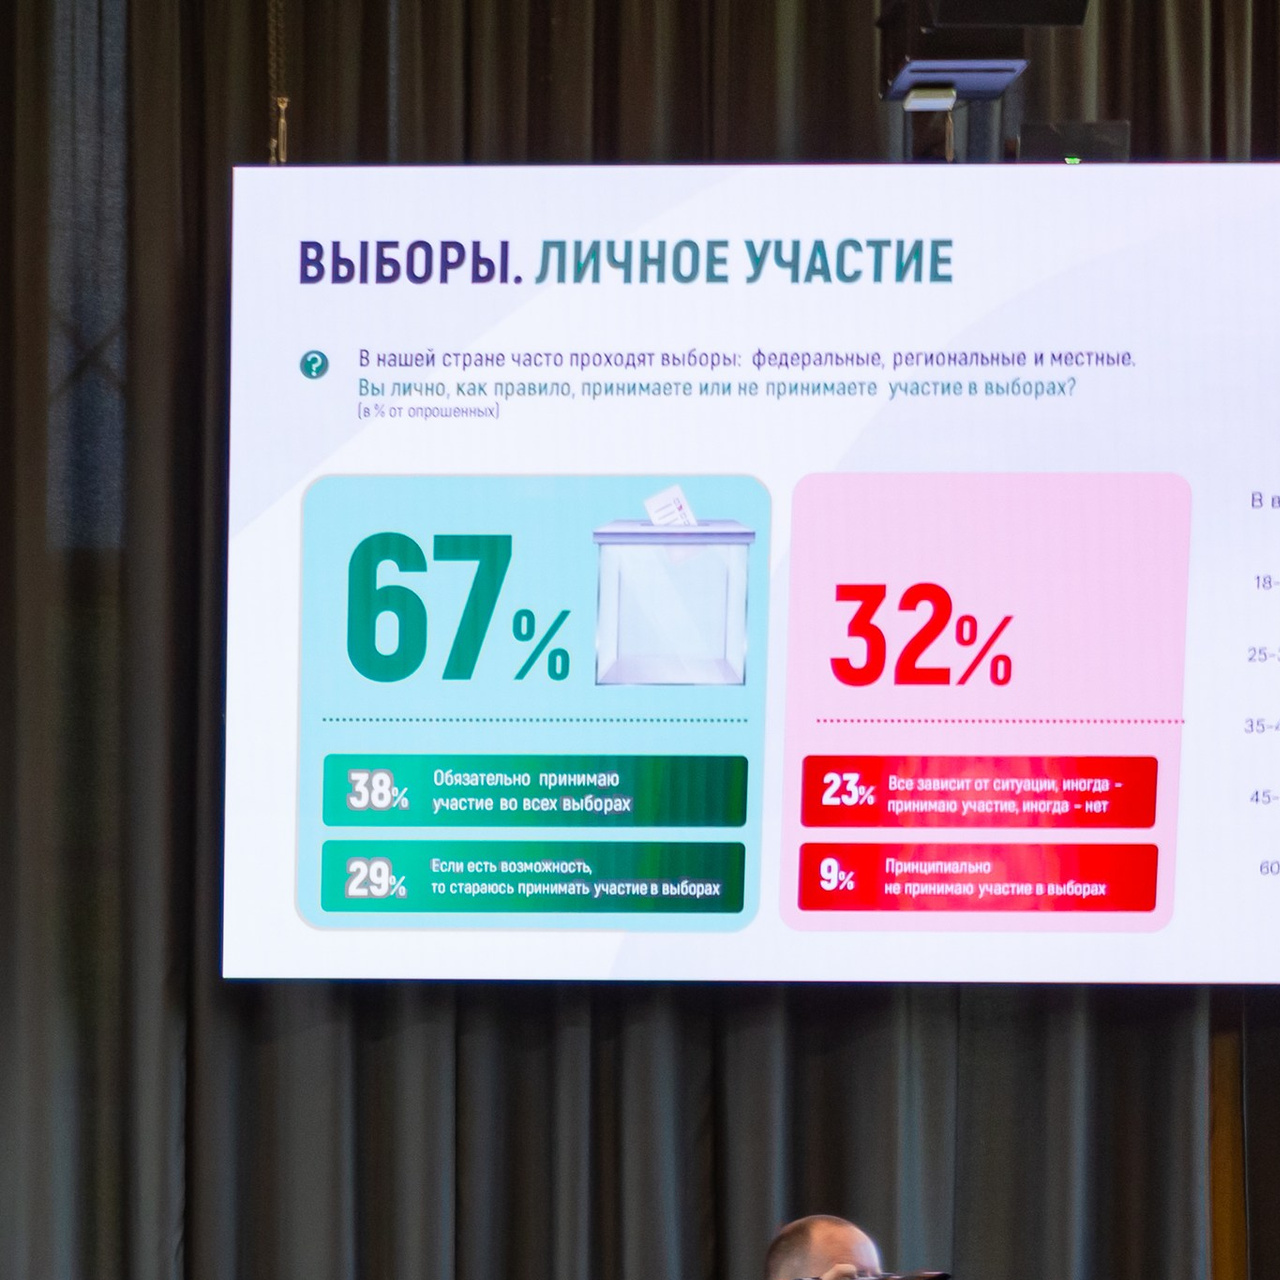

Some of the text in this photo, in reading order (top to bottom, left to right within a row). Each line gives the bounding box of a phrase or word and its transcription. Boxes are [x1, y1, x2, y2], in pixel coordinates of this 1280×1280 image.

[300, 239, 953, 285] ВЫБОРЫ. ЛИЧНОЕ УЧАСТИЕ
[360, 348, 1136, 371] В нашей стране часто проходят выборы: федеральные, региональные и местные.
[359, 377, 1077, 400] Вы лично, как правило, принимаете или не принимаете участие в выборах?
[374, 405, 385, 418] %
[389, 407, 403, 418] от
[1251, 491, 1263, 508] В
[347, 531, 572, 683] 67%
[830, 582, 1014, 687] 32%
[1248, 647, 1280, 662] 25-
[433, 769, 620, 788] Обязательно принимаю
[888, 774, 914, 791] Все
[917, 777, 971, 791] зависит
[974, 778, 989, 791] от
[993, 778, 1058, 794] ситуации,
[1063, 778, 1110, 794] иногда
[347, 770, 409, 810] 38%
[822, 772, 875, 806] 23%
[432, 794, 632, 814] участие во всех выборах
[888, 800, 957, 816] принимаю
[962, 800, 1019, 816] участие,
[1022, 800, 1070, 815] иногда
[1086, 800, 1109, 814] нет
[431, 858, 593, 875] Если есть возможность,
[820, 857, 855, 891] 9%
[885, 858, 992, 875] Принципиально
[347, 860, 407, 898] 29%
[432, 879, 721, 898] то стараюсь принимать участие в выборах
[884, 880, 1107, 898] не принимаю участие в выборах
